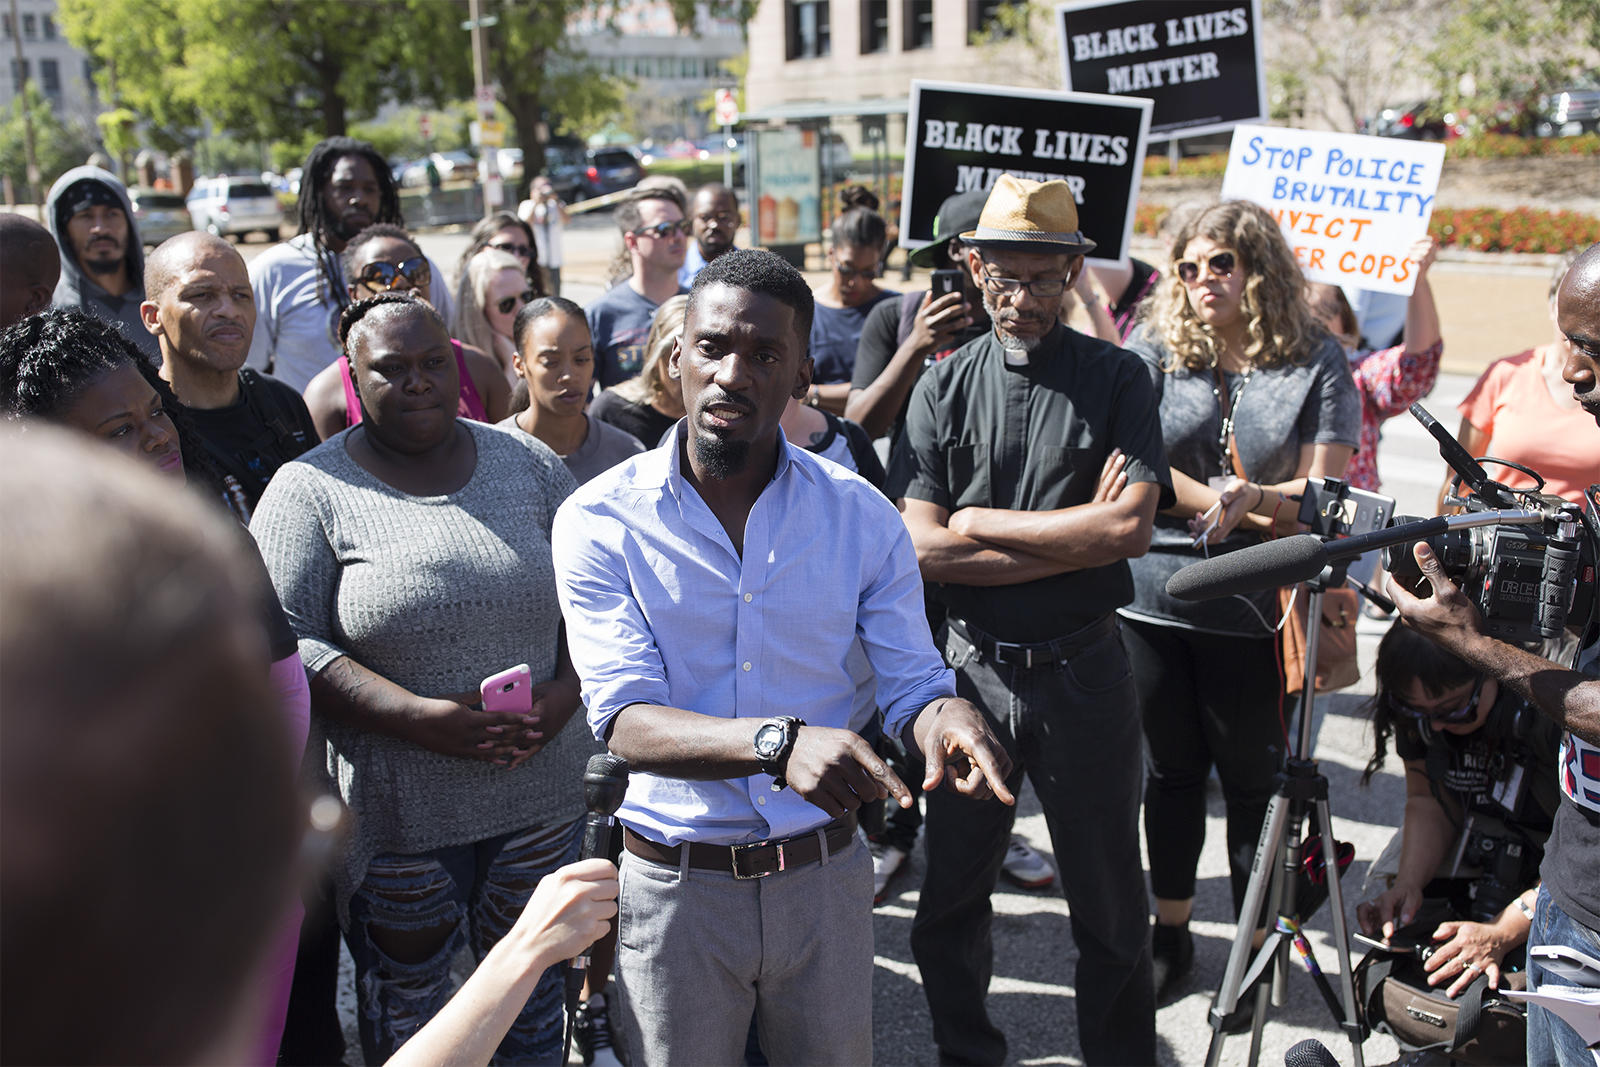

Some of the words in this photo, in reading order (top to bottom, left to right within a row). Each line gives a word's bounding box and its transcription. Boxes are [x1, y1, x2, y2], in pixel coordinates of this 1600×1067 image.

[1072, 23, 1159, 62] BLACK
[1165, 8, 1248, 47] LIVES
[1106, 52, 1220, 94] MATTER
[924, 119, 1023, 156] BLACK
[1033, 128, 1129, 166] LIVES
[1243, 137, 1312, 171] STOP
[1325, 149, 1424, 185] POLICE
[1273, 177, 1434, 216] BRUTALITY
[1339, 251, 1415, 283] COPS
